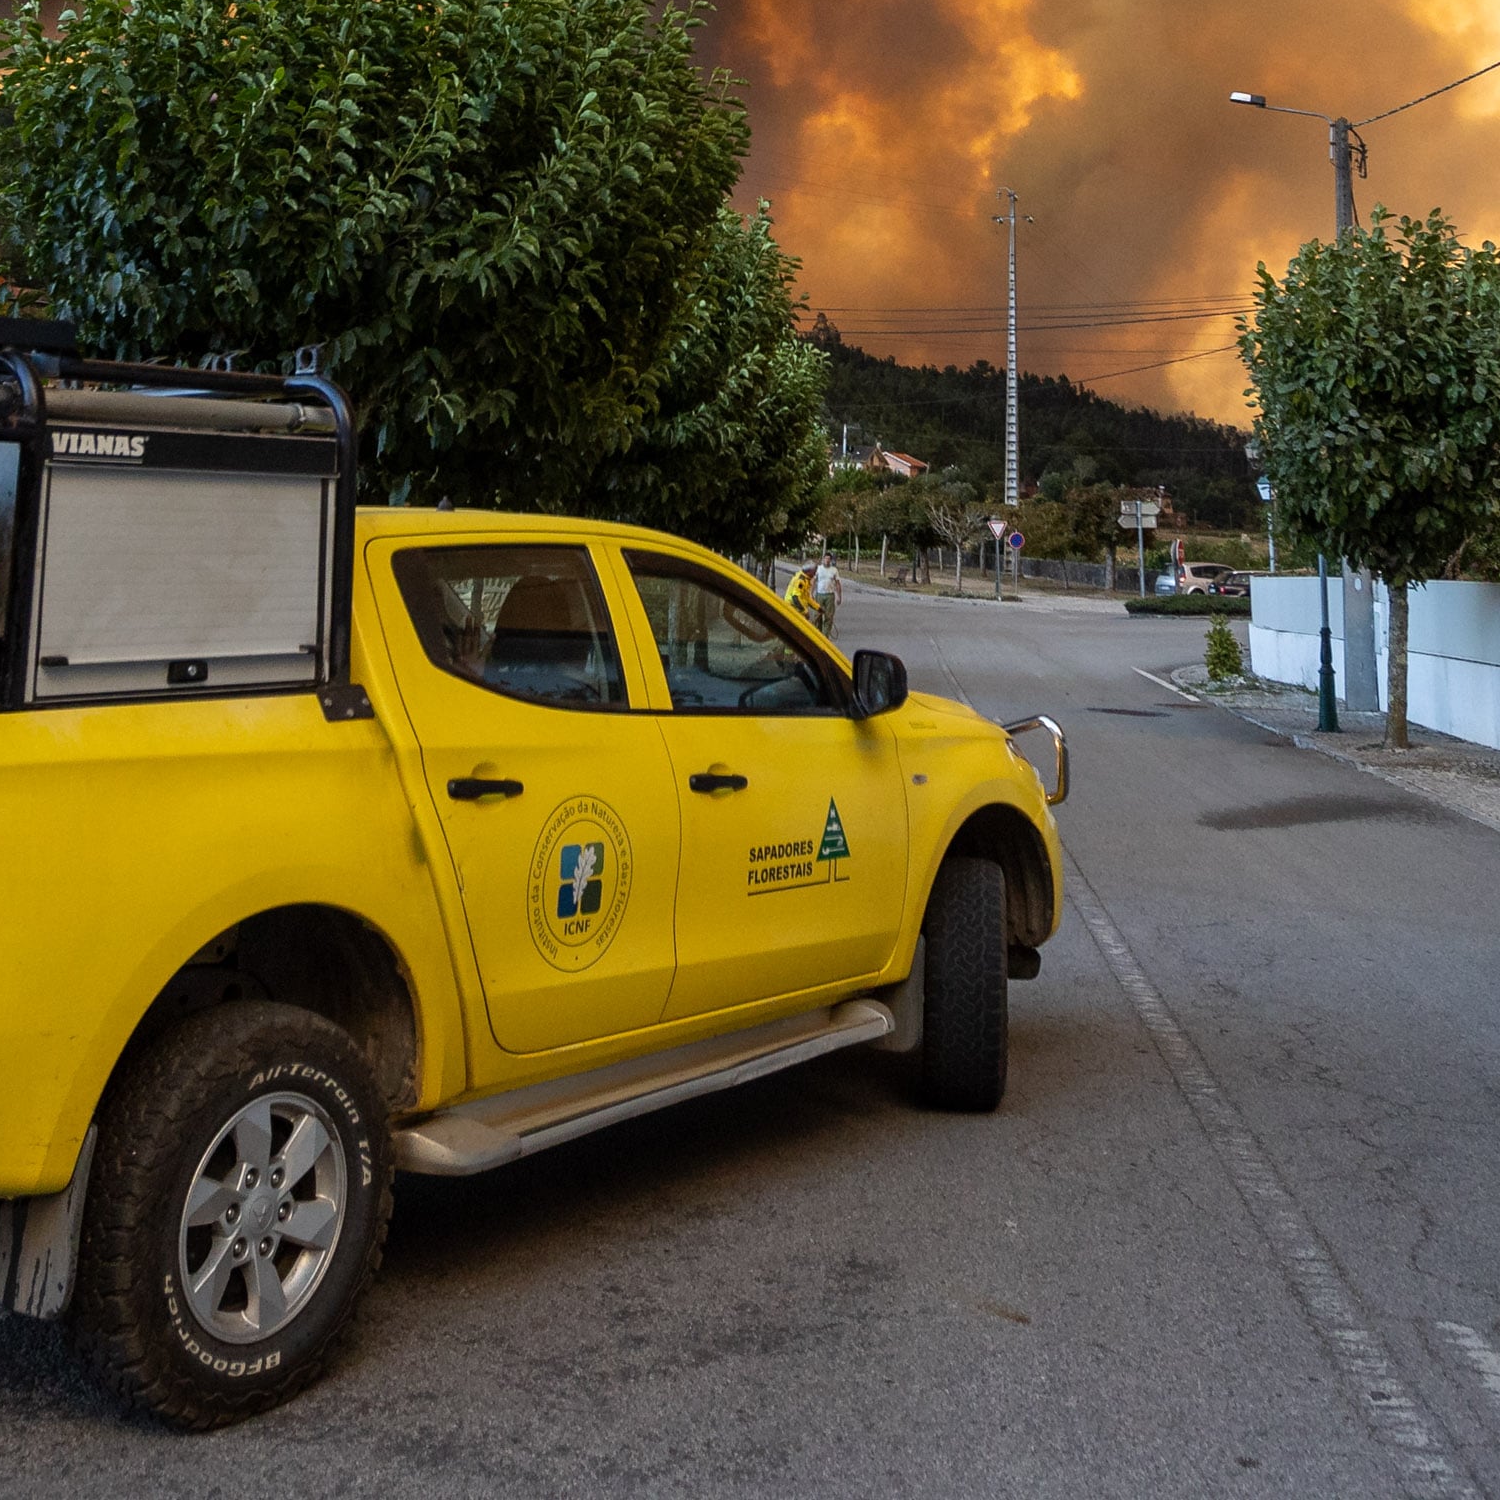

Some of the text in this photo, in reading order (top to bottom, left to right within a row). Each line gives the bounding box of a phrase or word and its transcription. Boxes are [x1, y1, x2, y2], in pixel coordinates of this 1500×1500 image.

[51, 432, 145, 457] VIANAS
[749, 840, 814, 863] SAPADORES
[531, 800, 630, 960] Instituto da Conservação da Natureza e das Florestas
[747, 861, 813, 886] FLORESTAIS
[563, 919, 591, 936] ICNF
[359, 1137, 372, 1186] T/A
[164, 1274, 281, 1377] BFGoodrich
